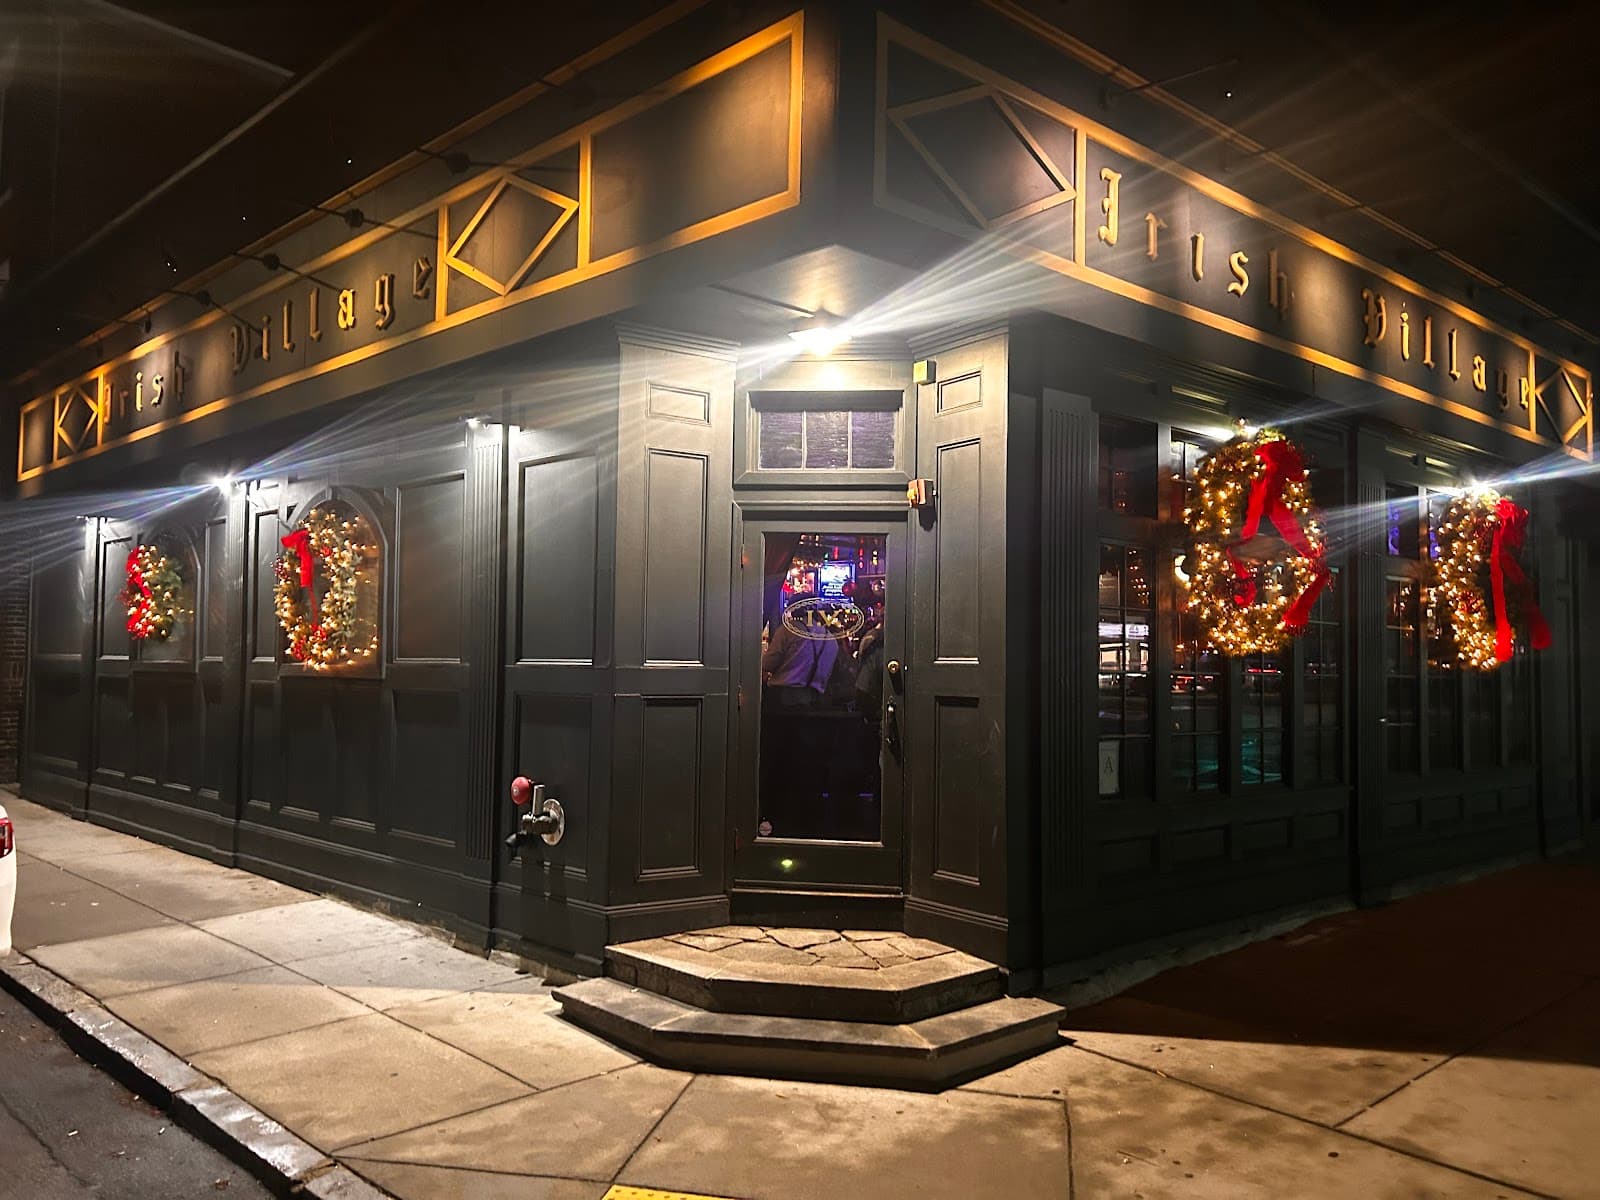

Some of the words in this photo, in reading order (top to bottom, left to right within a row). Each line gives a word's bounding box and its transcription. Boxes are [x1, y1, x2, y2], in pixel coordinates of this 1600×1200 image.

[231, 257, 433, 374] Village
[1099, 168, 1288, 319] Irish
[1362, 288, 1529, 412] Village
